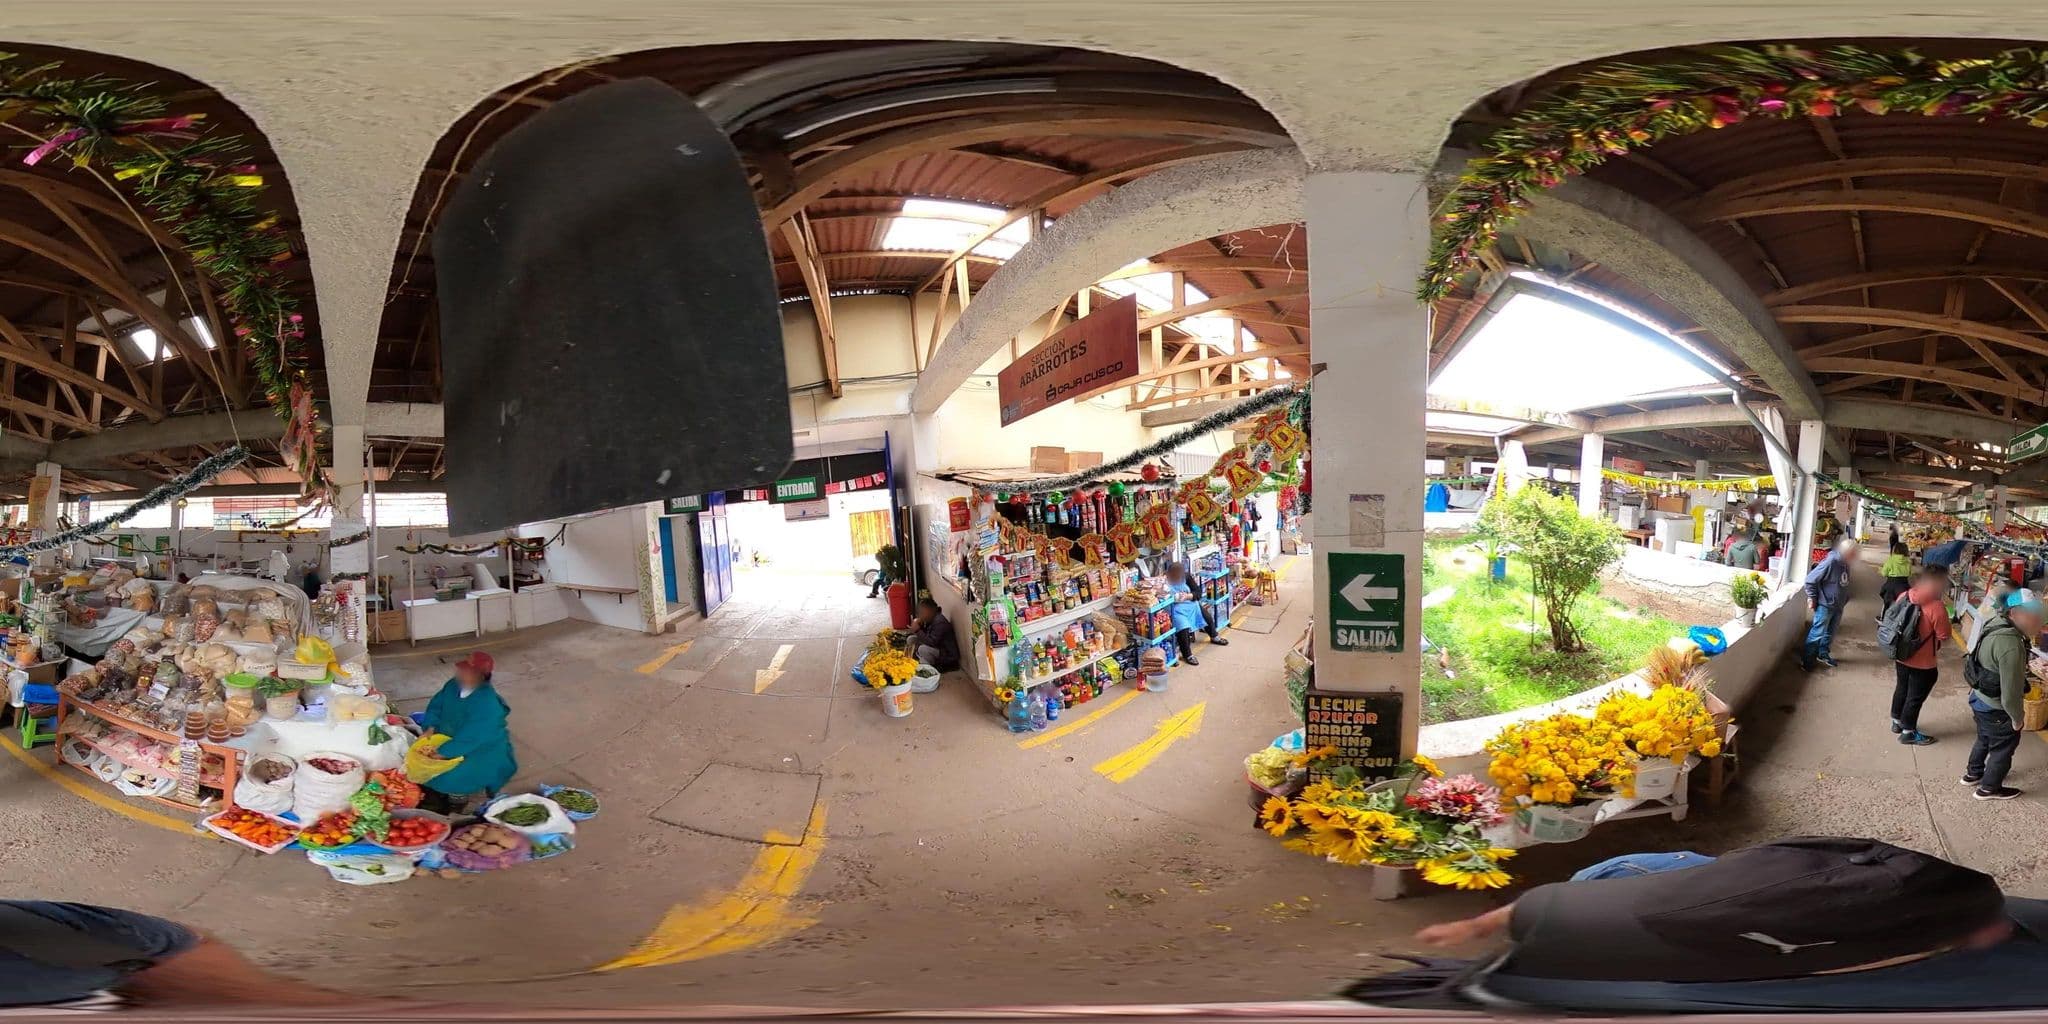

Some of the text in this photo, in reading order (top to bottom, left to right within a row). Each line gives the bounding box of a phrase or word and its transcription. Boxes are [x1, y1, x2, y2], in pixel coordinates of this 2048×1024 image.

[1020, 340, 1087, 388] ABARROTES
[1057, 361, 1123, 394] CAJA CUSCO
[777, 482, 815, 498] ENTRADA
[672, 496, 699, 509] SALIDA
[1337, 628, 1397, 647] SALIDA
[1309, 697, 1366, 712] LECHE
[1308, 711, 1378, 725] AZUCAR
[1308, 724, 1363, 736] ARROZ
[1307, 735, 1372, 747] HARINA
